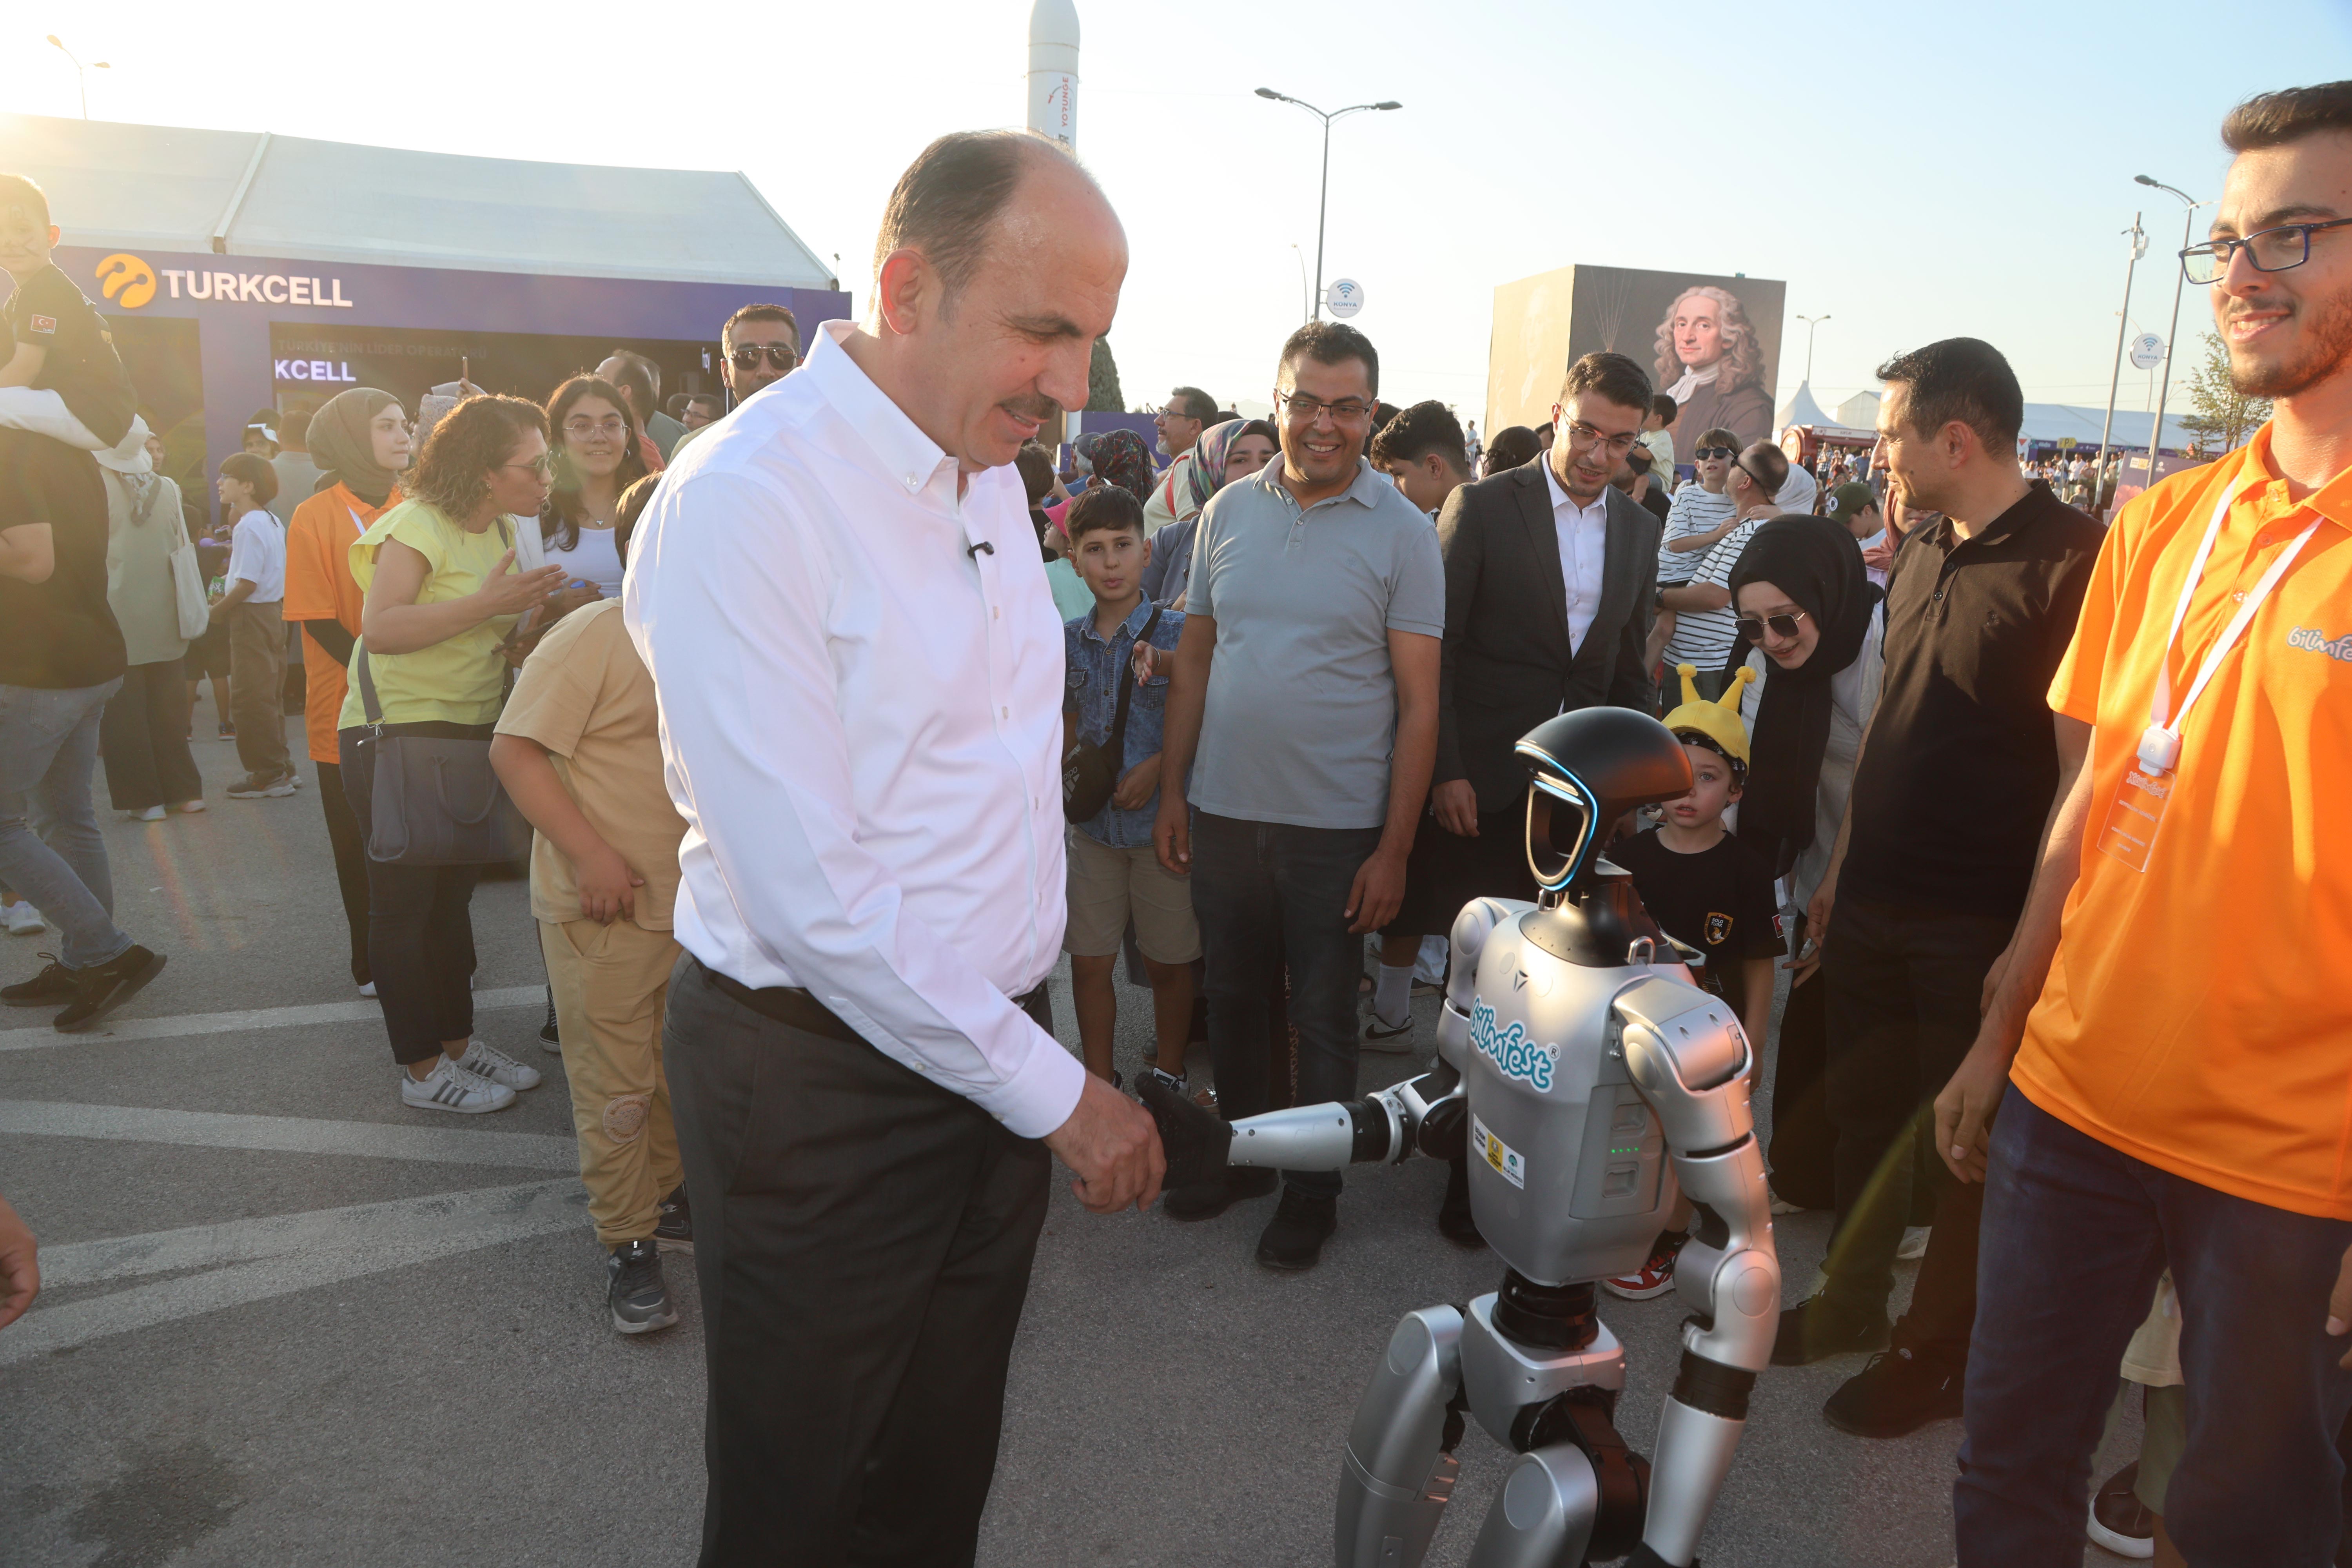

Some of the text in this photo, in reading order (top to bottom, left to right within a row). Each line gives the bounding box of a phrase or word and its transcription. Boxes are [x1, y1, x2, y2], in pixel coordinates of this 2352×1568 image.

[162, 269, 353, 307] TURKCELL
[367, 342, 403, 356] LİDER
[276, 359, 356, 381] KCELL
[2064, 438, 2069, 447] P
[1062, 766, 1078, 783] adid
[1471, 998, 1551, 1088] bilimfest
